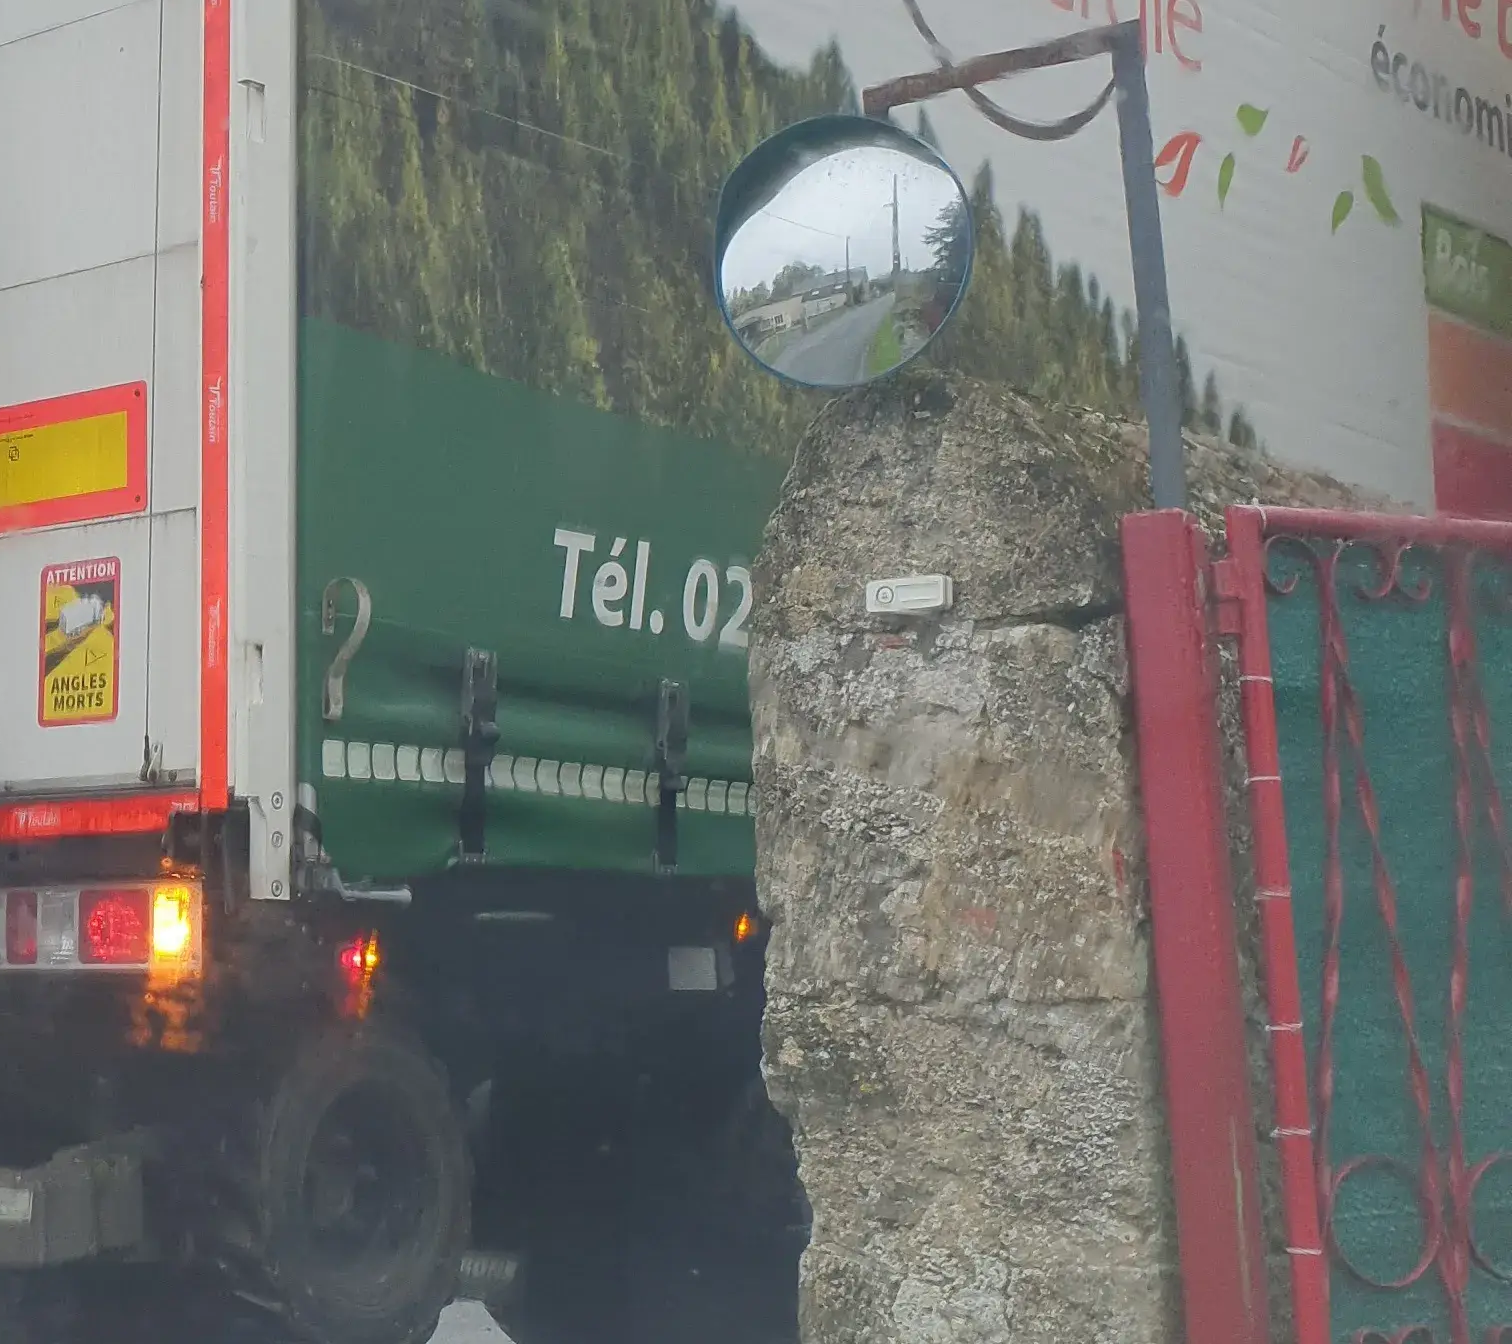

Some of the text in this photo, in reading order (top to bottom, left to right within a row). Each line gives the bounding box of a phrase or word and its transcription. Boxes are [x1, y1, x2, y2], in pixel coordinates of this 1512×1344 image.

[46, 562, 116, 586] ATTENTION
[553, 528, 754, 648] Tél. 02
[51, 672, 107, 694] ANGLES
[53, 691, 104, 712] MORTS
